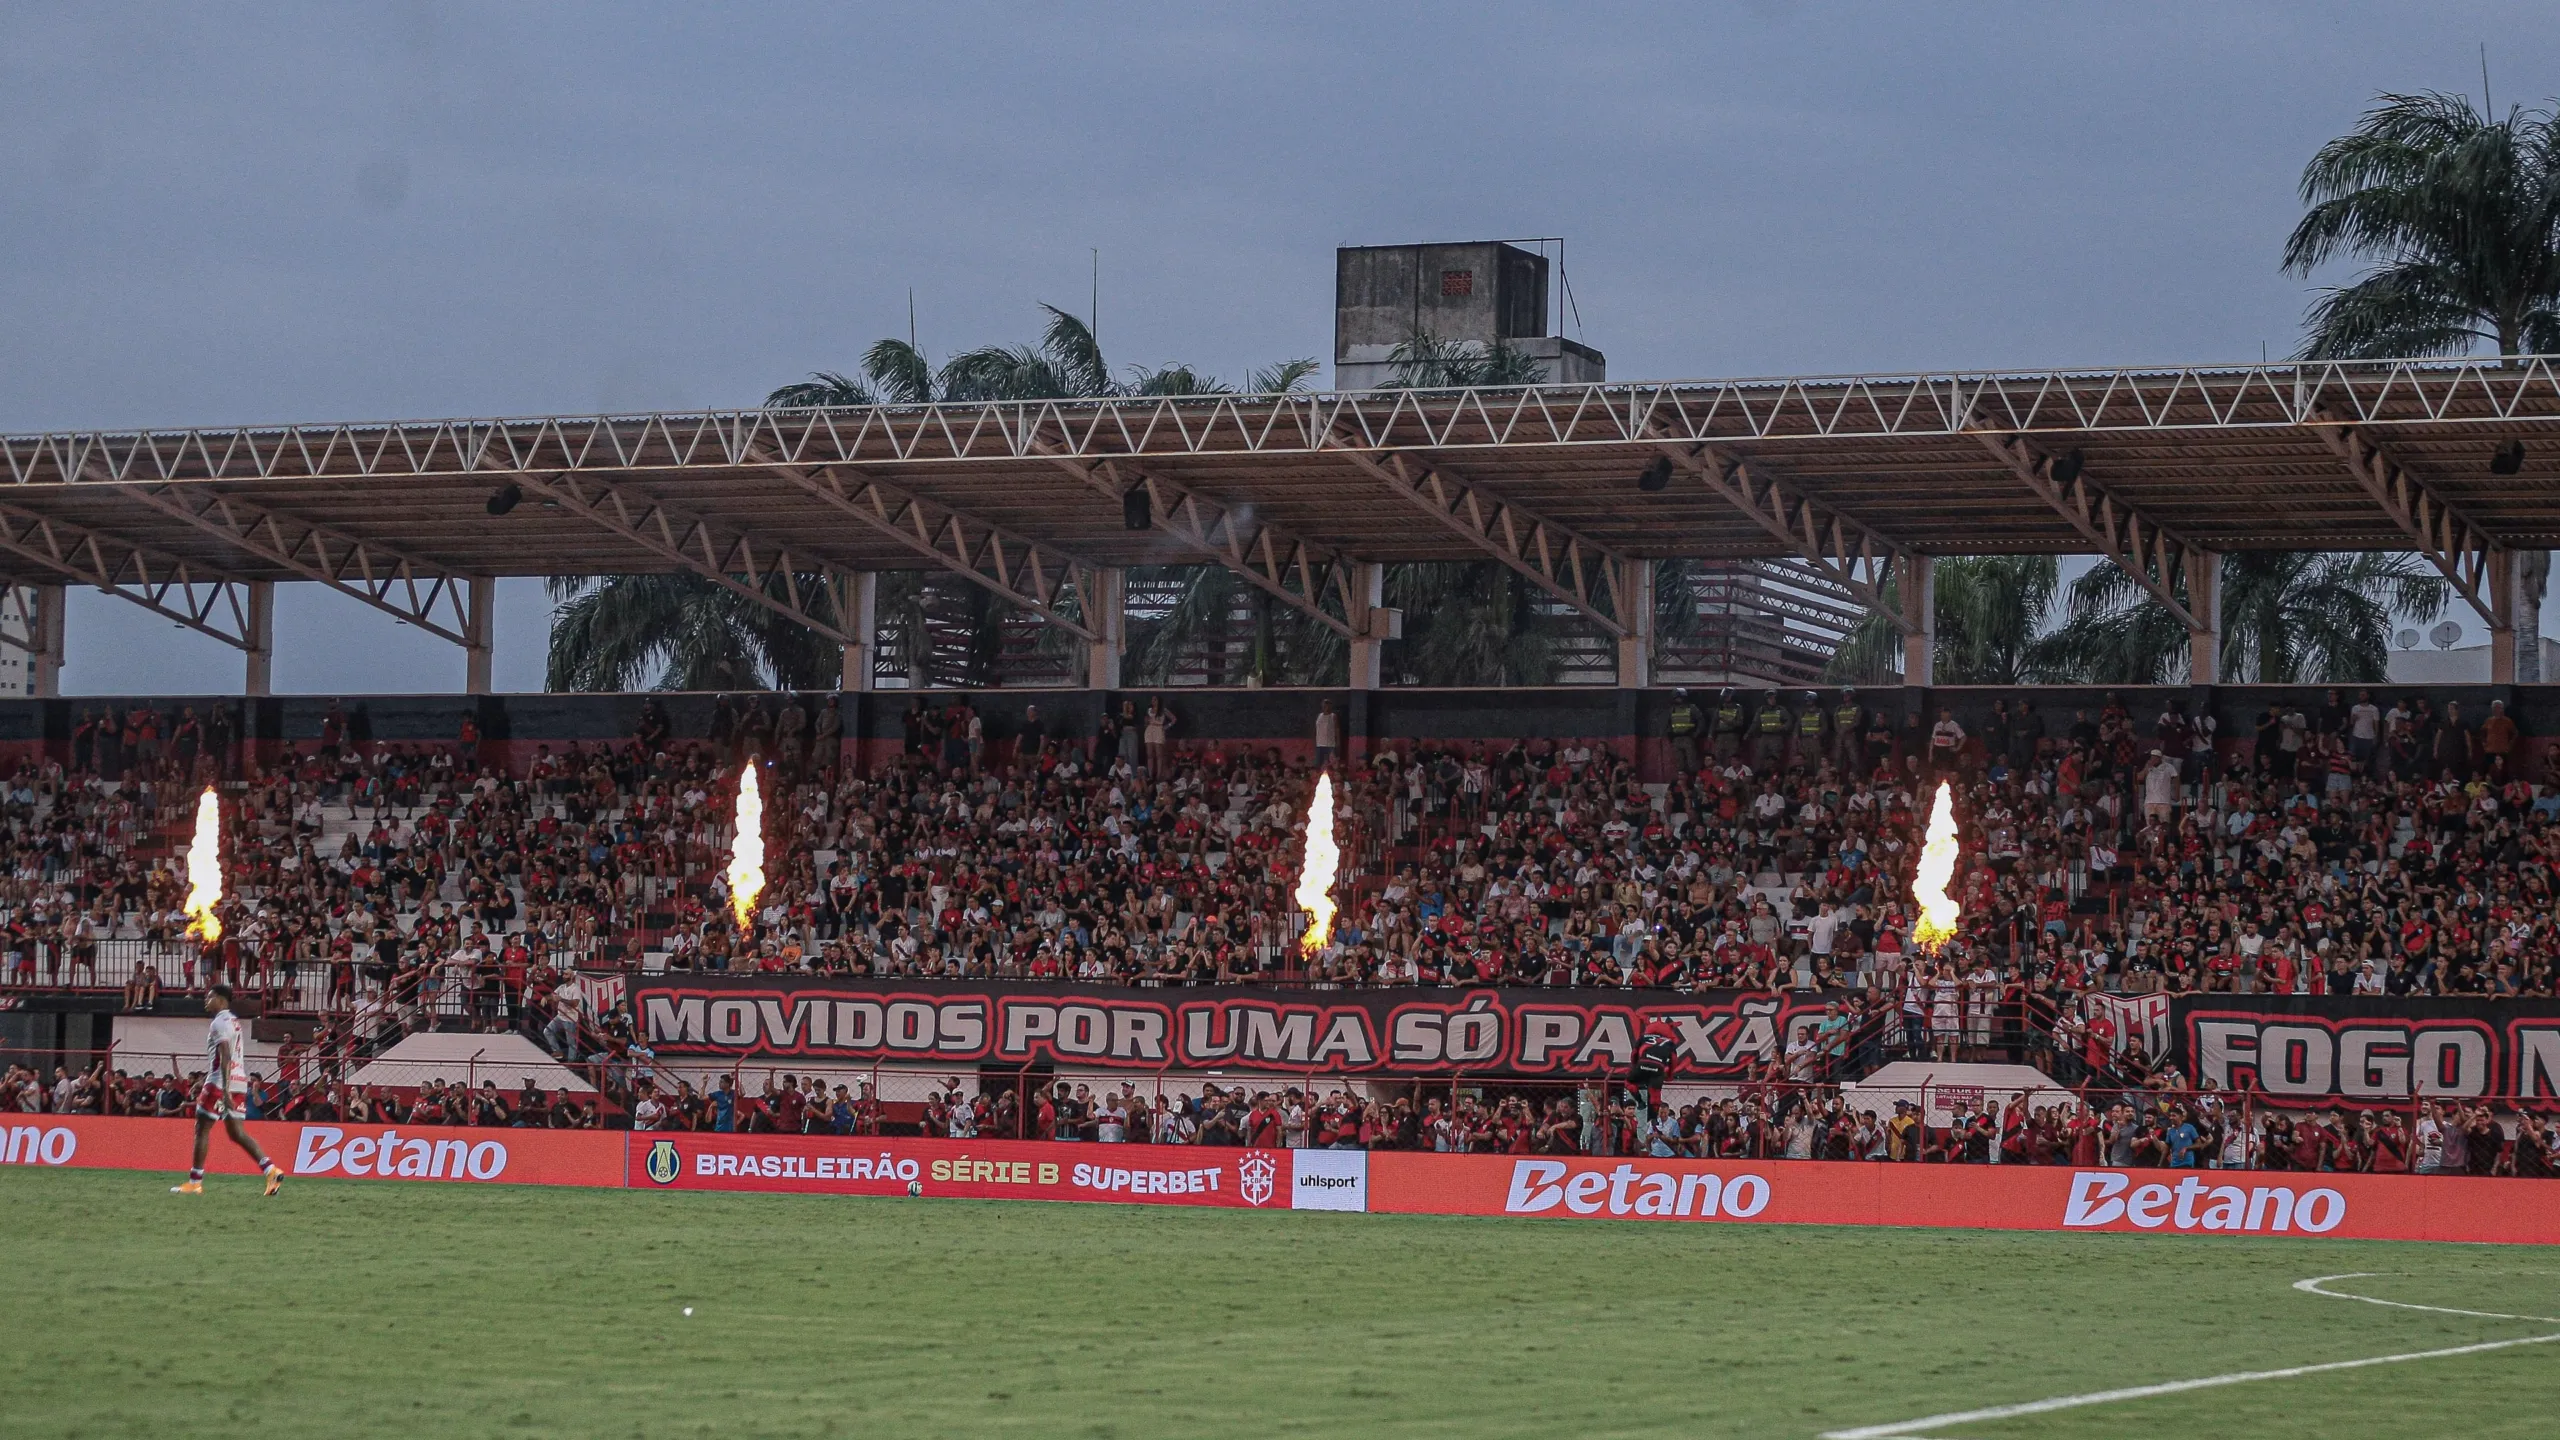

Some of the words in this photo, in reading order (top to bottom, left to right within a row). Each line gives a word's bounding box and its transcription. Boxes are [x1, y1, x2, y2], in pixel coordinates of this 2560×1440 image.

[646, 998, 983, 1050] MOVIDOS
[1005, 1007, 1163, 1058] POR
[1188, 1008, 1372, 1062] UMA
[1394, 999, 1499, 1061] SÓ
[2198, 1021, 2486, 1097] FOGO
[293, 1126, 507, 1180] Betano
[696, 1152, 920, 1181] BRASILEIRÃO
[931, 1153, 1031, 1184] SÉRIE
[1039, 1163, 1059, 1185] B
[1071, 1163, 1222, 1194] SUPERBET
[1300, 1175, 1356, 1190] uhlsport
[1505, 1159, 1771, 1218] Betano
[2063, 1171, 2346, 1233] Betano
